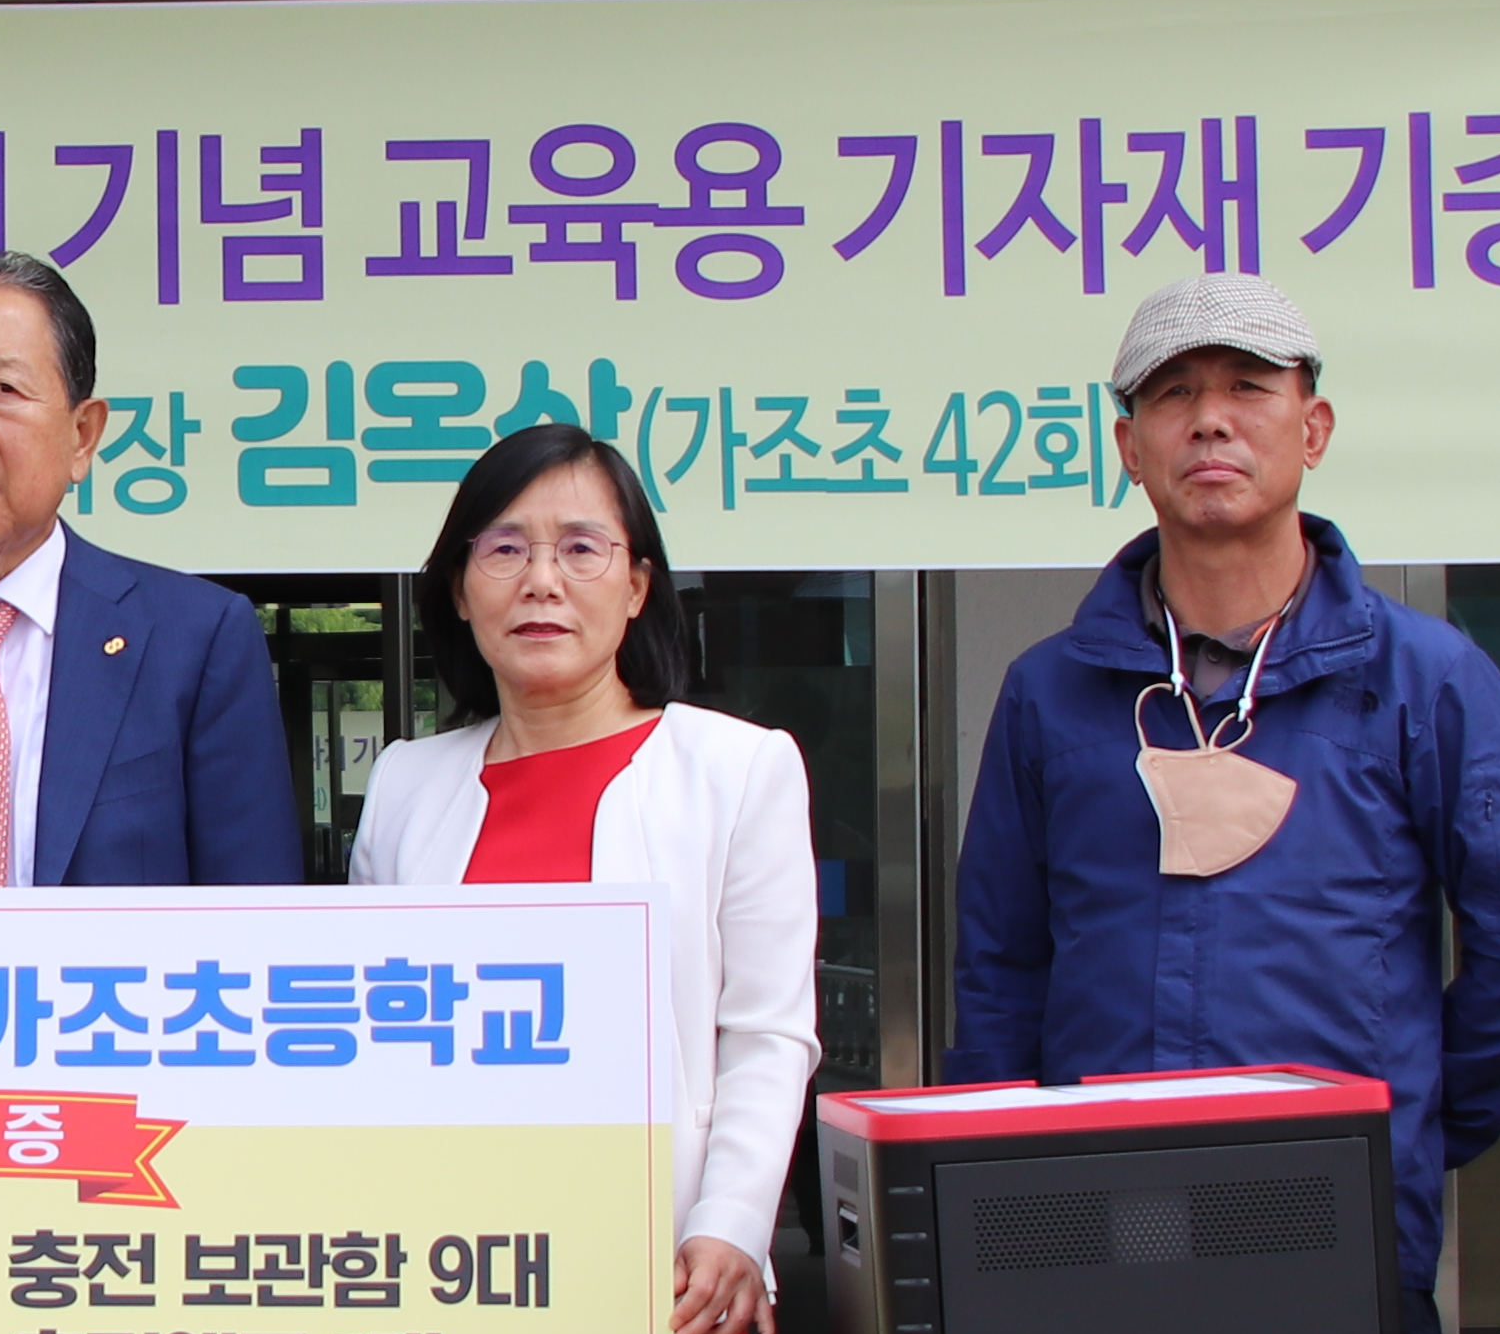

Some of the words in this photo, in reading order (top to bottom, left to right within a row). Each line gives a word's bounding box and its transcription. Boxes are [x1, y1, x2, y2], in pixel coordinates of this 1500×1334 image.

[48, 128, 324, 304] 기념
[365, 122, 805, 301] 교육용
[832, 118, 1260, 297] 기자재
[7, 1230, 156, 1308] 충전
[183, 1230, 406, 1308] 보관함
[432, 1233, 551, 1309] 9대
